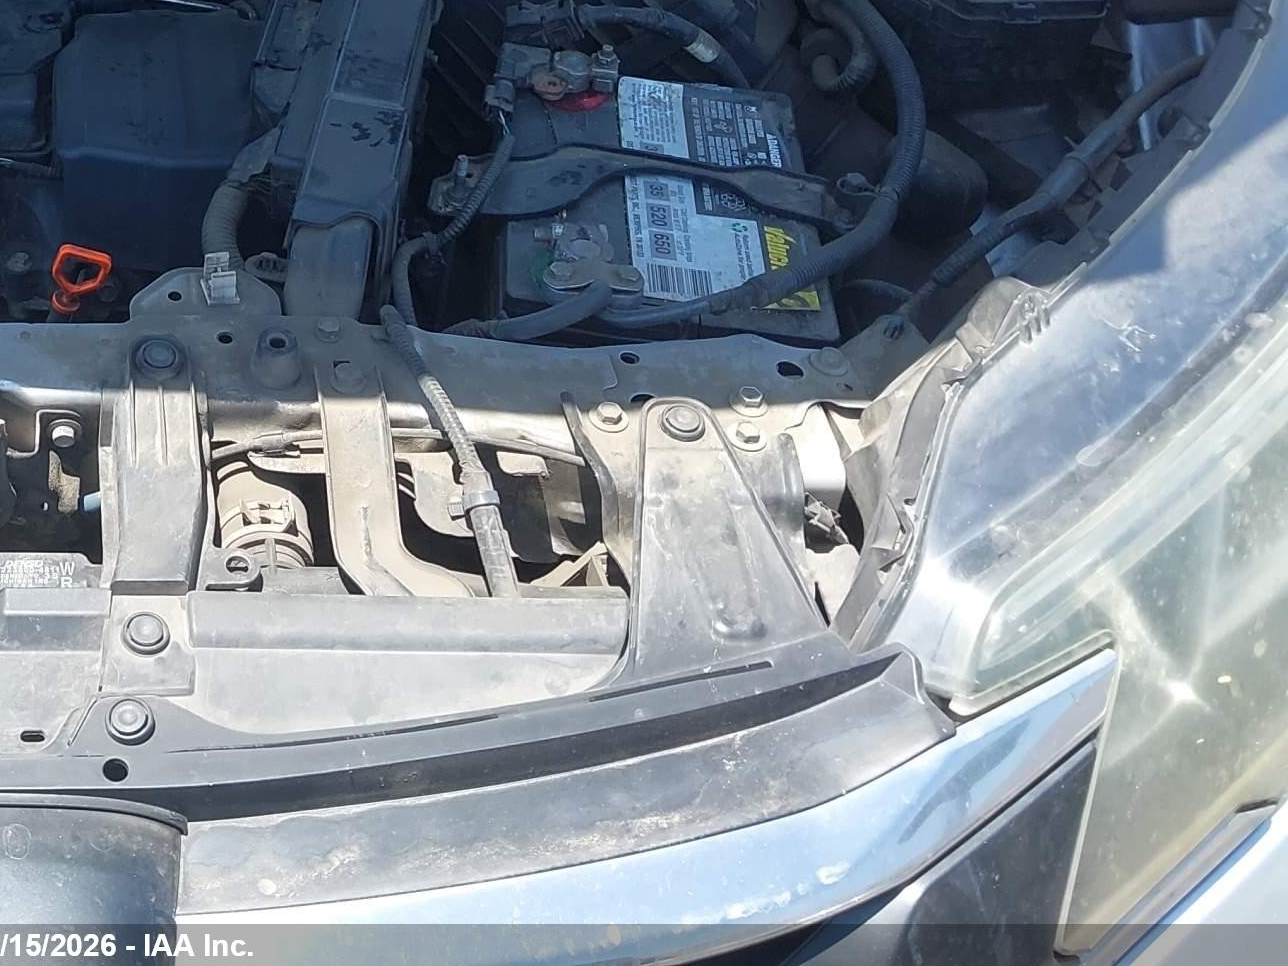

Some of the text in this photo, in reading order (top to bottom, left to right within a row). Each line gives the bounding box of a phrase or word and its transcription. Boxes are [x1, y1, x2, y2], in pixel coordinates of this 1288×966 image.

[650, 185, 663, 197] 35
[650, 206, 667, 226] 520
[653, 234, 672, 255] 650
